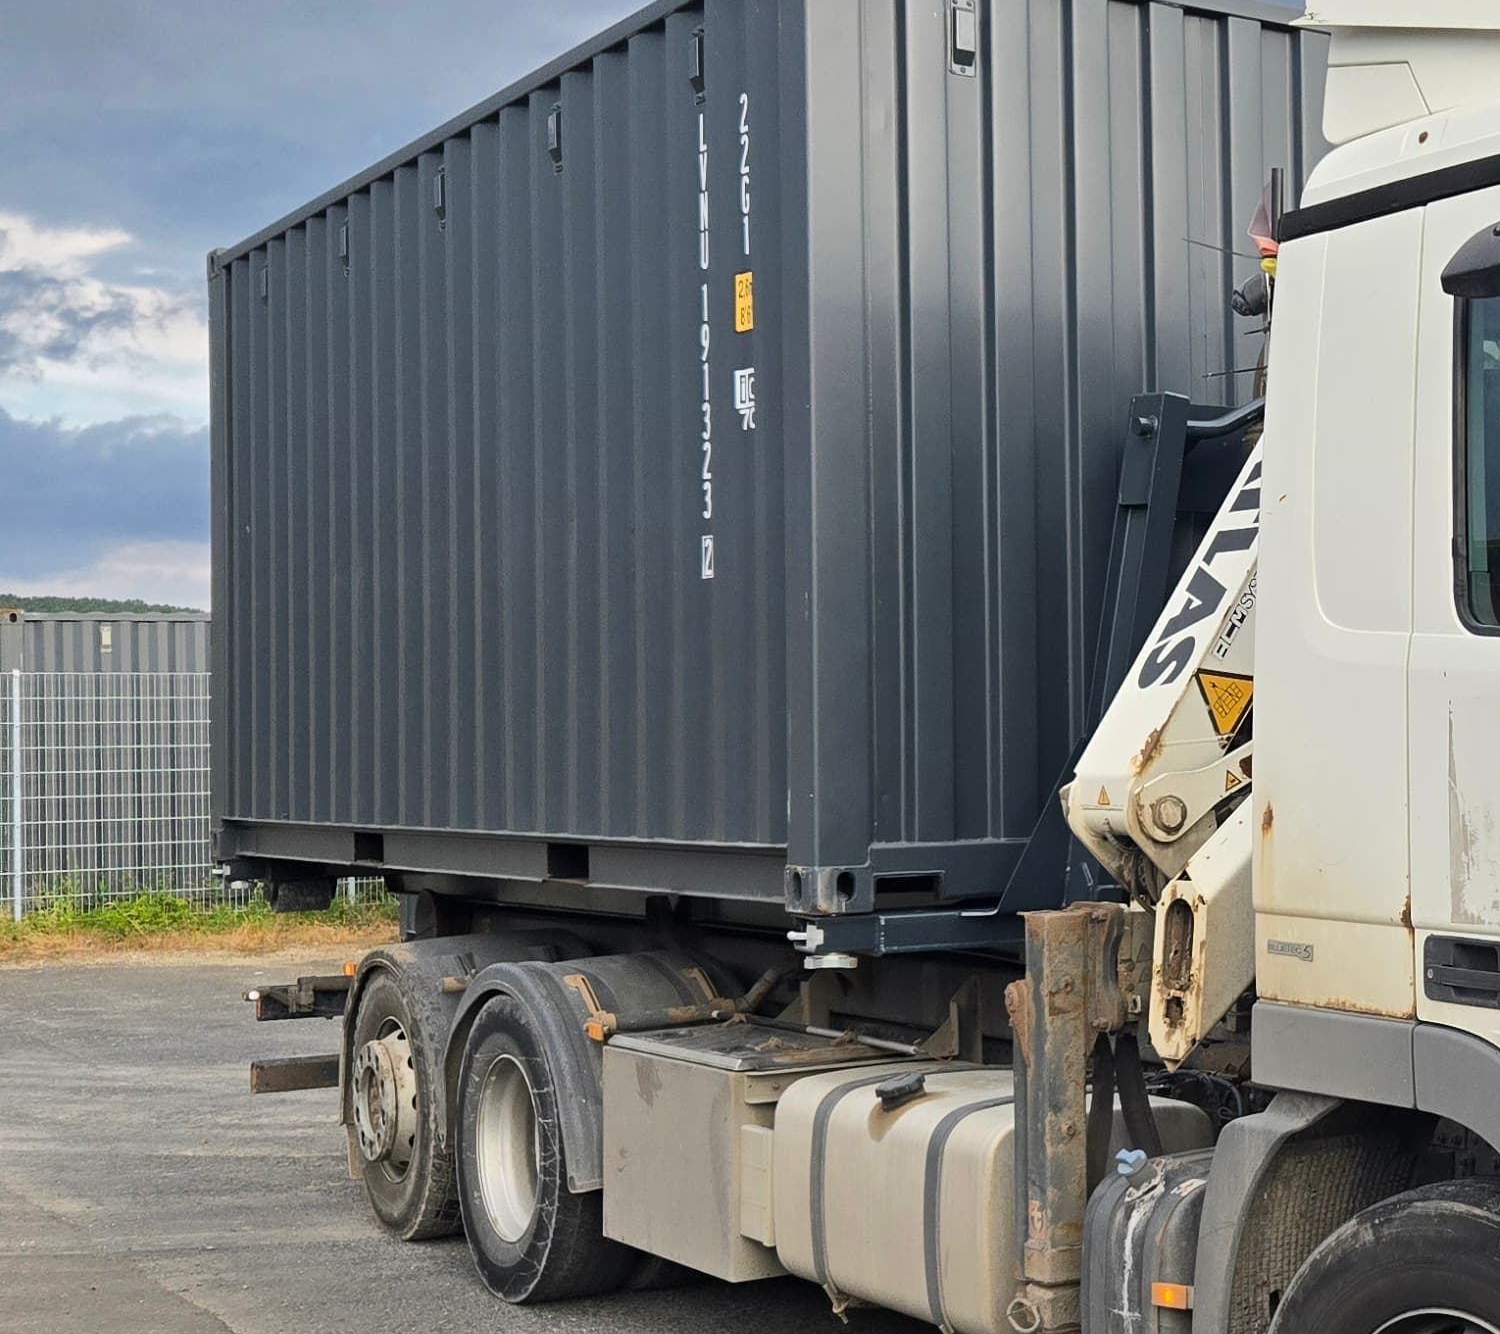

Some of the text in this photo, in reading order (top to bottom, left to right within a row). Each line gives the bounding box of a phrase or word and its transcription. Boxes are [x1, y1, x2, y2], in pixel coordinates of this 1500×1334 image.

[699, 112, 709, 270] LVNU
[739, 92, 751, 256] 22G1
[701, 282, 712, 519] 191323
